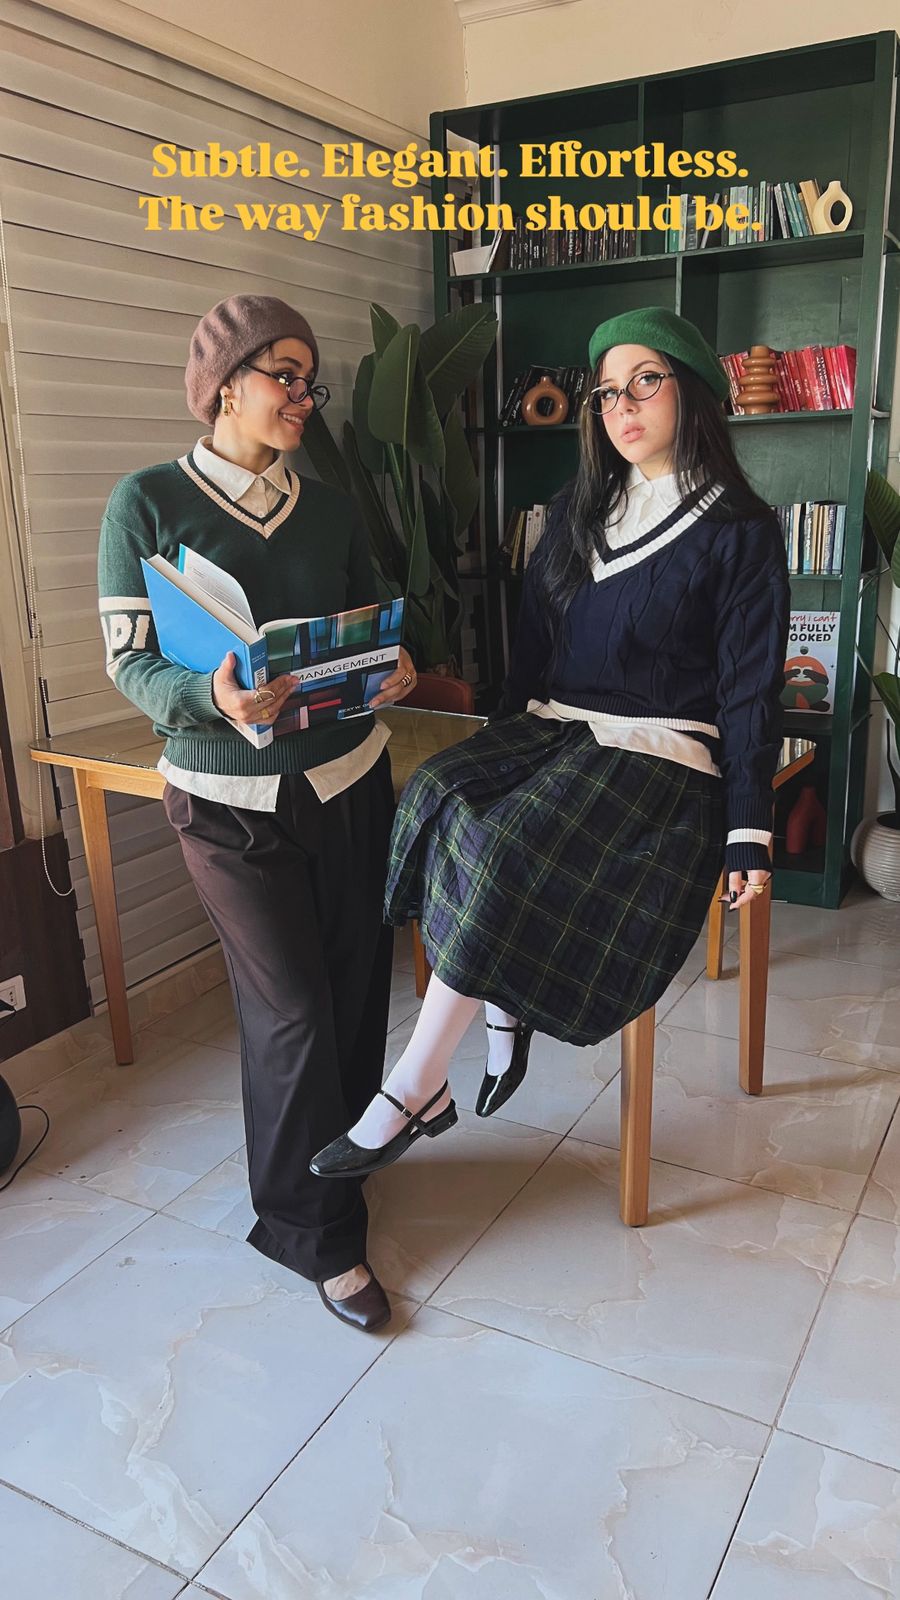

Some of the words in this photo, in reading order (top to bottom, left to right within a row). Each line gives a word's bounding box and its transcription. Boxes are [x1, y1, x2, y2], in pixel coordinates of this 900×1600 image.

[791, 615, 806, 625] rry
[800, 624, 836, 632] FULLY
[790, 633, 831, 642] OOKED
